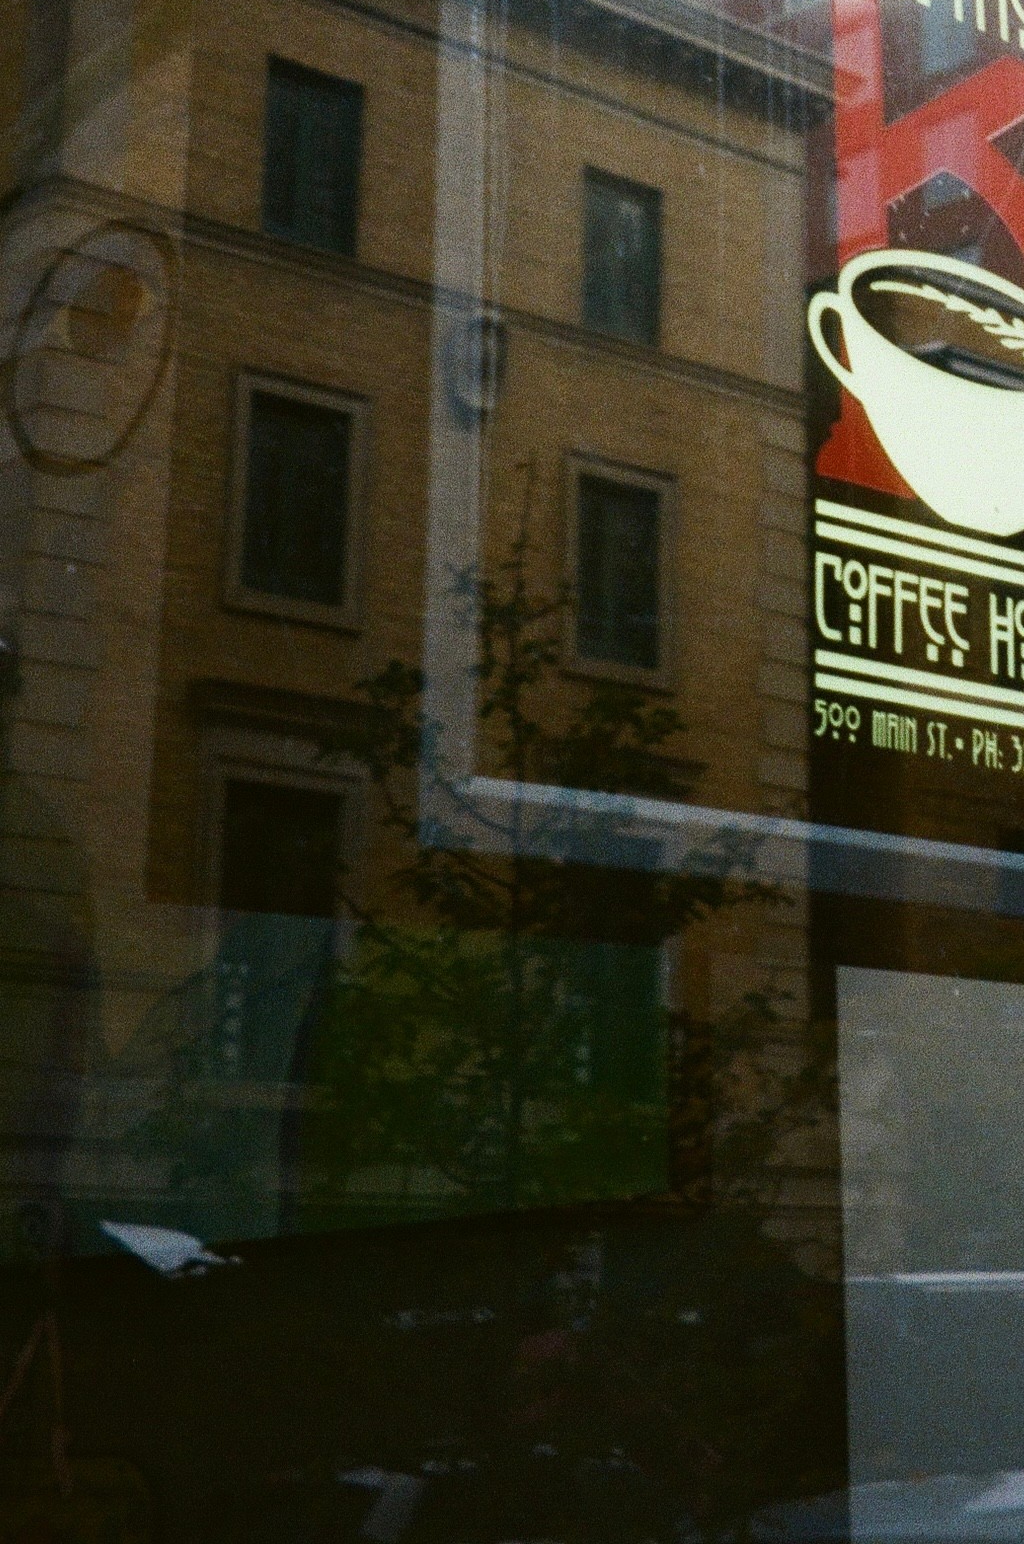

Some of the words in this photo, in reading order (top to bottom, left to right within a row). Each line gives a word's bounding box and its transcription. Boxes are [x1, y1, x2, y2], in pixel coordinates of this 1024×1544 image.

[815, 551, 969, 667] COFFEE
[814, 699, 861, 743] 500
[872, 710, 918, 754] MAIN
